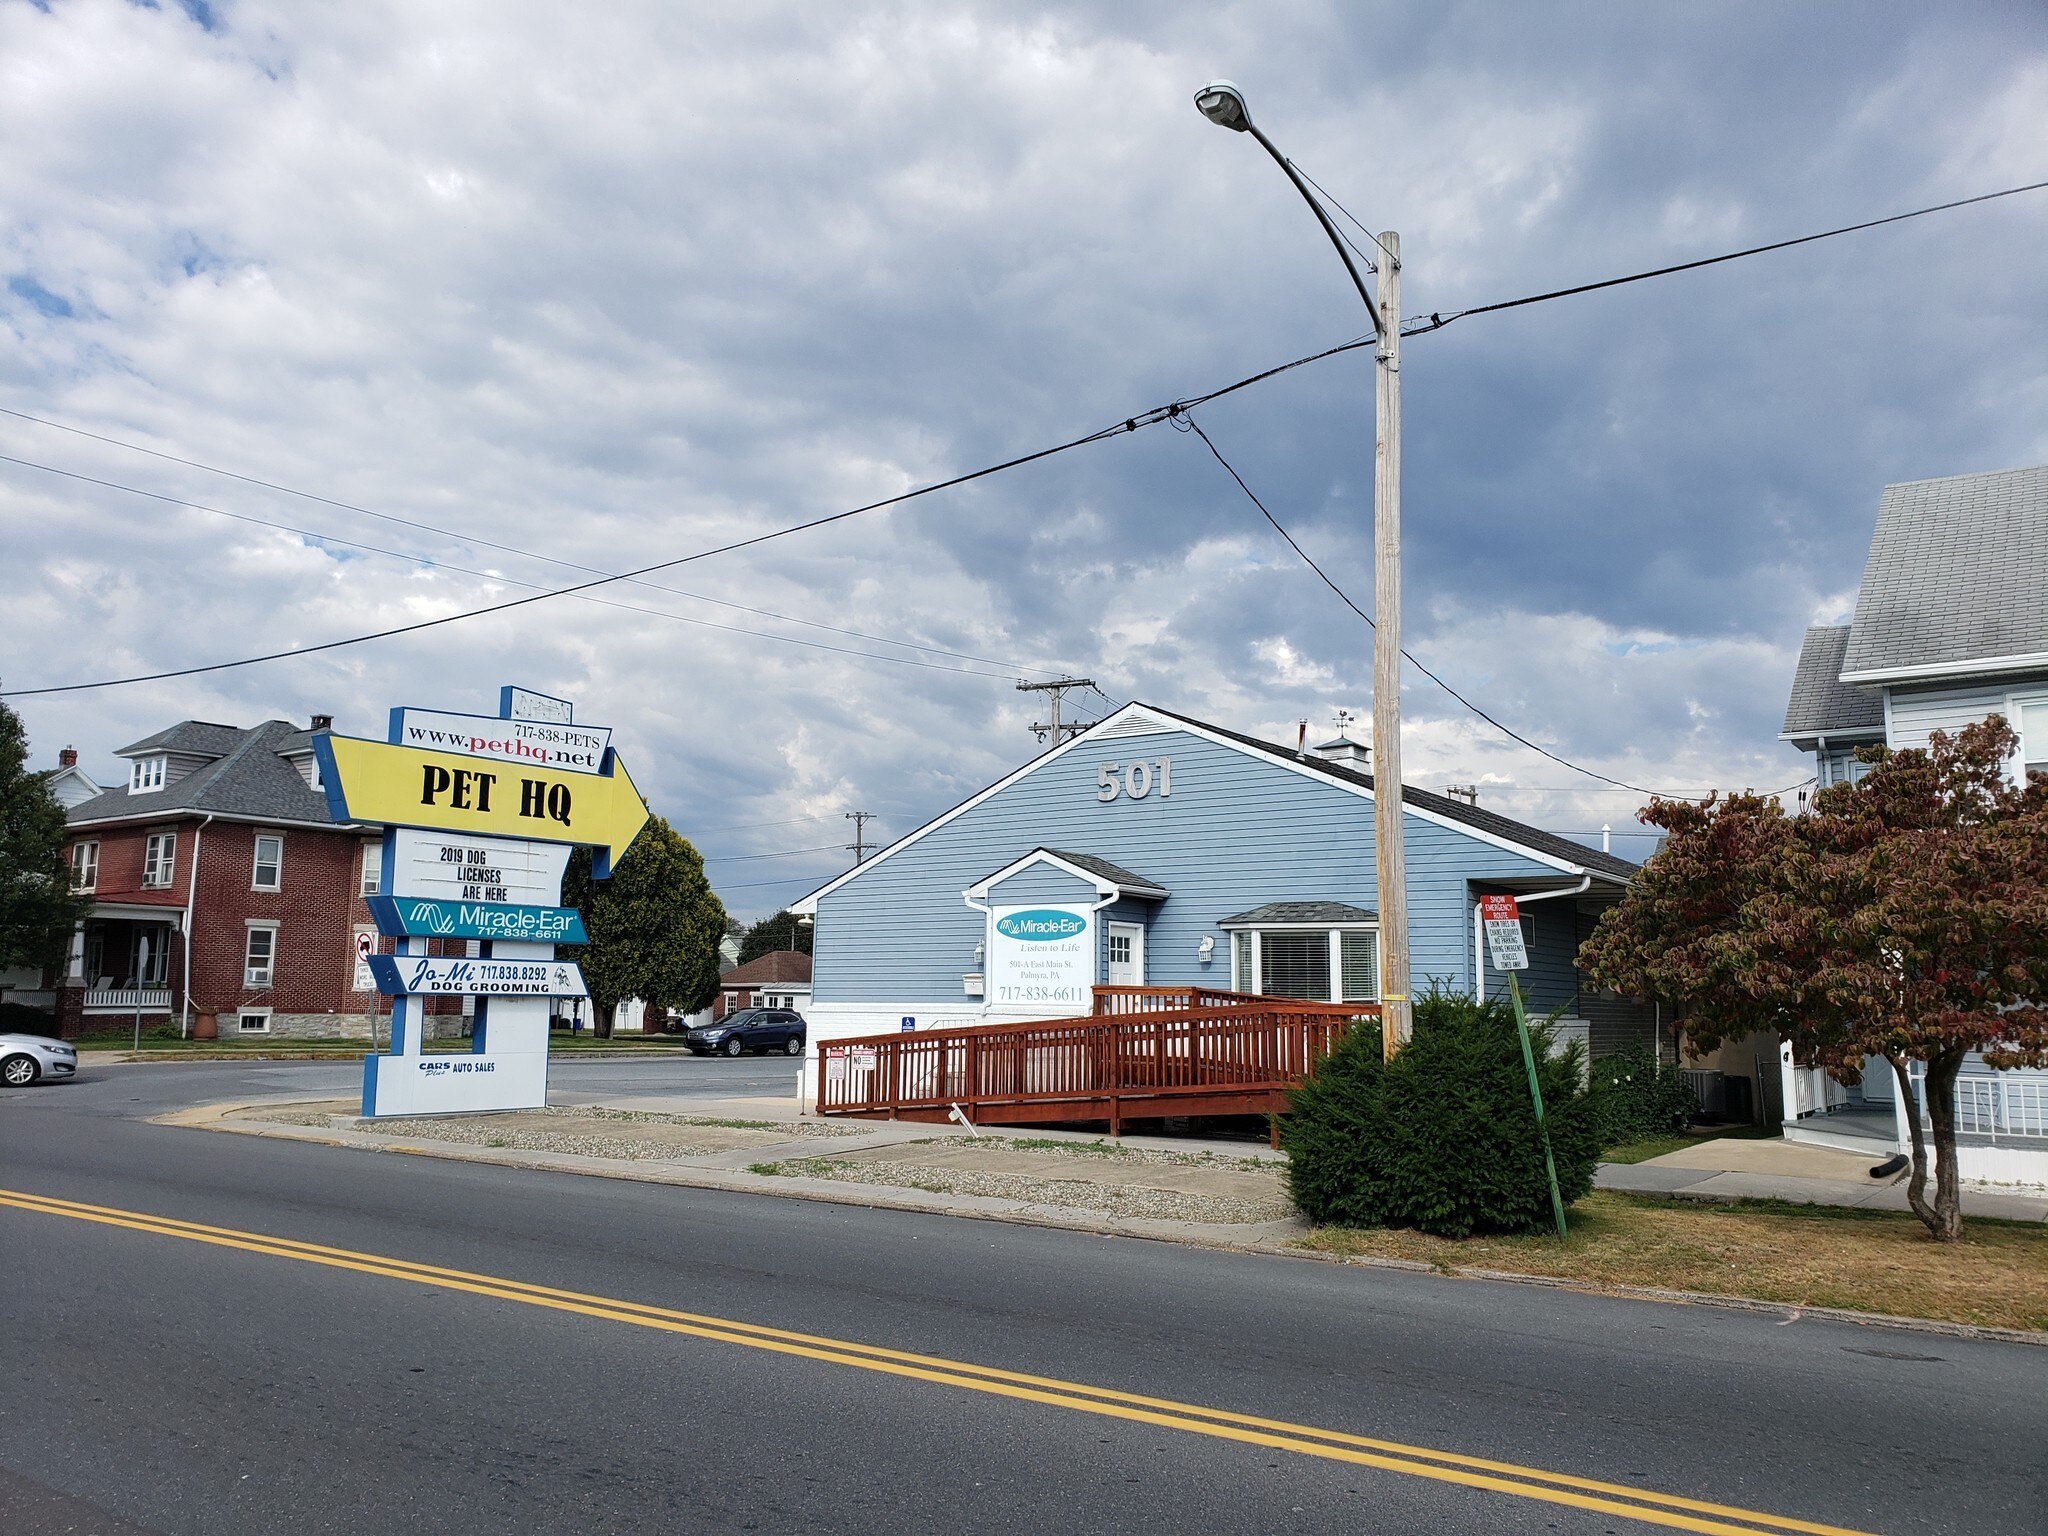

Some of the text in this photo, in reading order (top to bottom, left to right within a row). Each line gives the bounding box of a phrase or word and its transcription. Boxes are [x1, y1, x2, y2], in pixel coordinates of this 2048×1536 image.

[514, 724, 600, 749] 717-838-PETS
[408, 727, 596, 767] www.pethq.net
[1097, 756, 1171, 802] 501
[420, 765, 572, 827] PET HQ
[440, 846, 486, 865] 2019 DOG
[457, 867, 501, 884] LICENSES
[462, 885, 508, 902] ARE HERE
[1490, 895, 1505, 903] SNOW
[1485, 904, 1513, 912] EMERGENCY
[1493, 912, 1509, 920] ROUTE
[477, 926, 562, 939] 717-838-6611
[1501, 936, 1518, 944] PARKING
[1020, 943, 1080, 952] Listen to Life
[1009, 960, 1073, 969] 501-A East Main St.
[408, 959, 547, 992] Jo-Mi 717.838.8292
[1020, 971, 1060, 981] Palmyra, PA
[431, 982, 550, 993] DOG GROOMING
[999, 986, 1082, 1001] 717-838-6611
[853, 1056, 862, 1065] NO
[418, 1062, 495, 1073] CARS AUTO SALES
[424, 1069, 446, 1078] Plus
